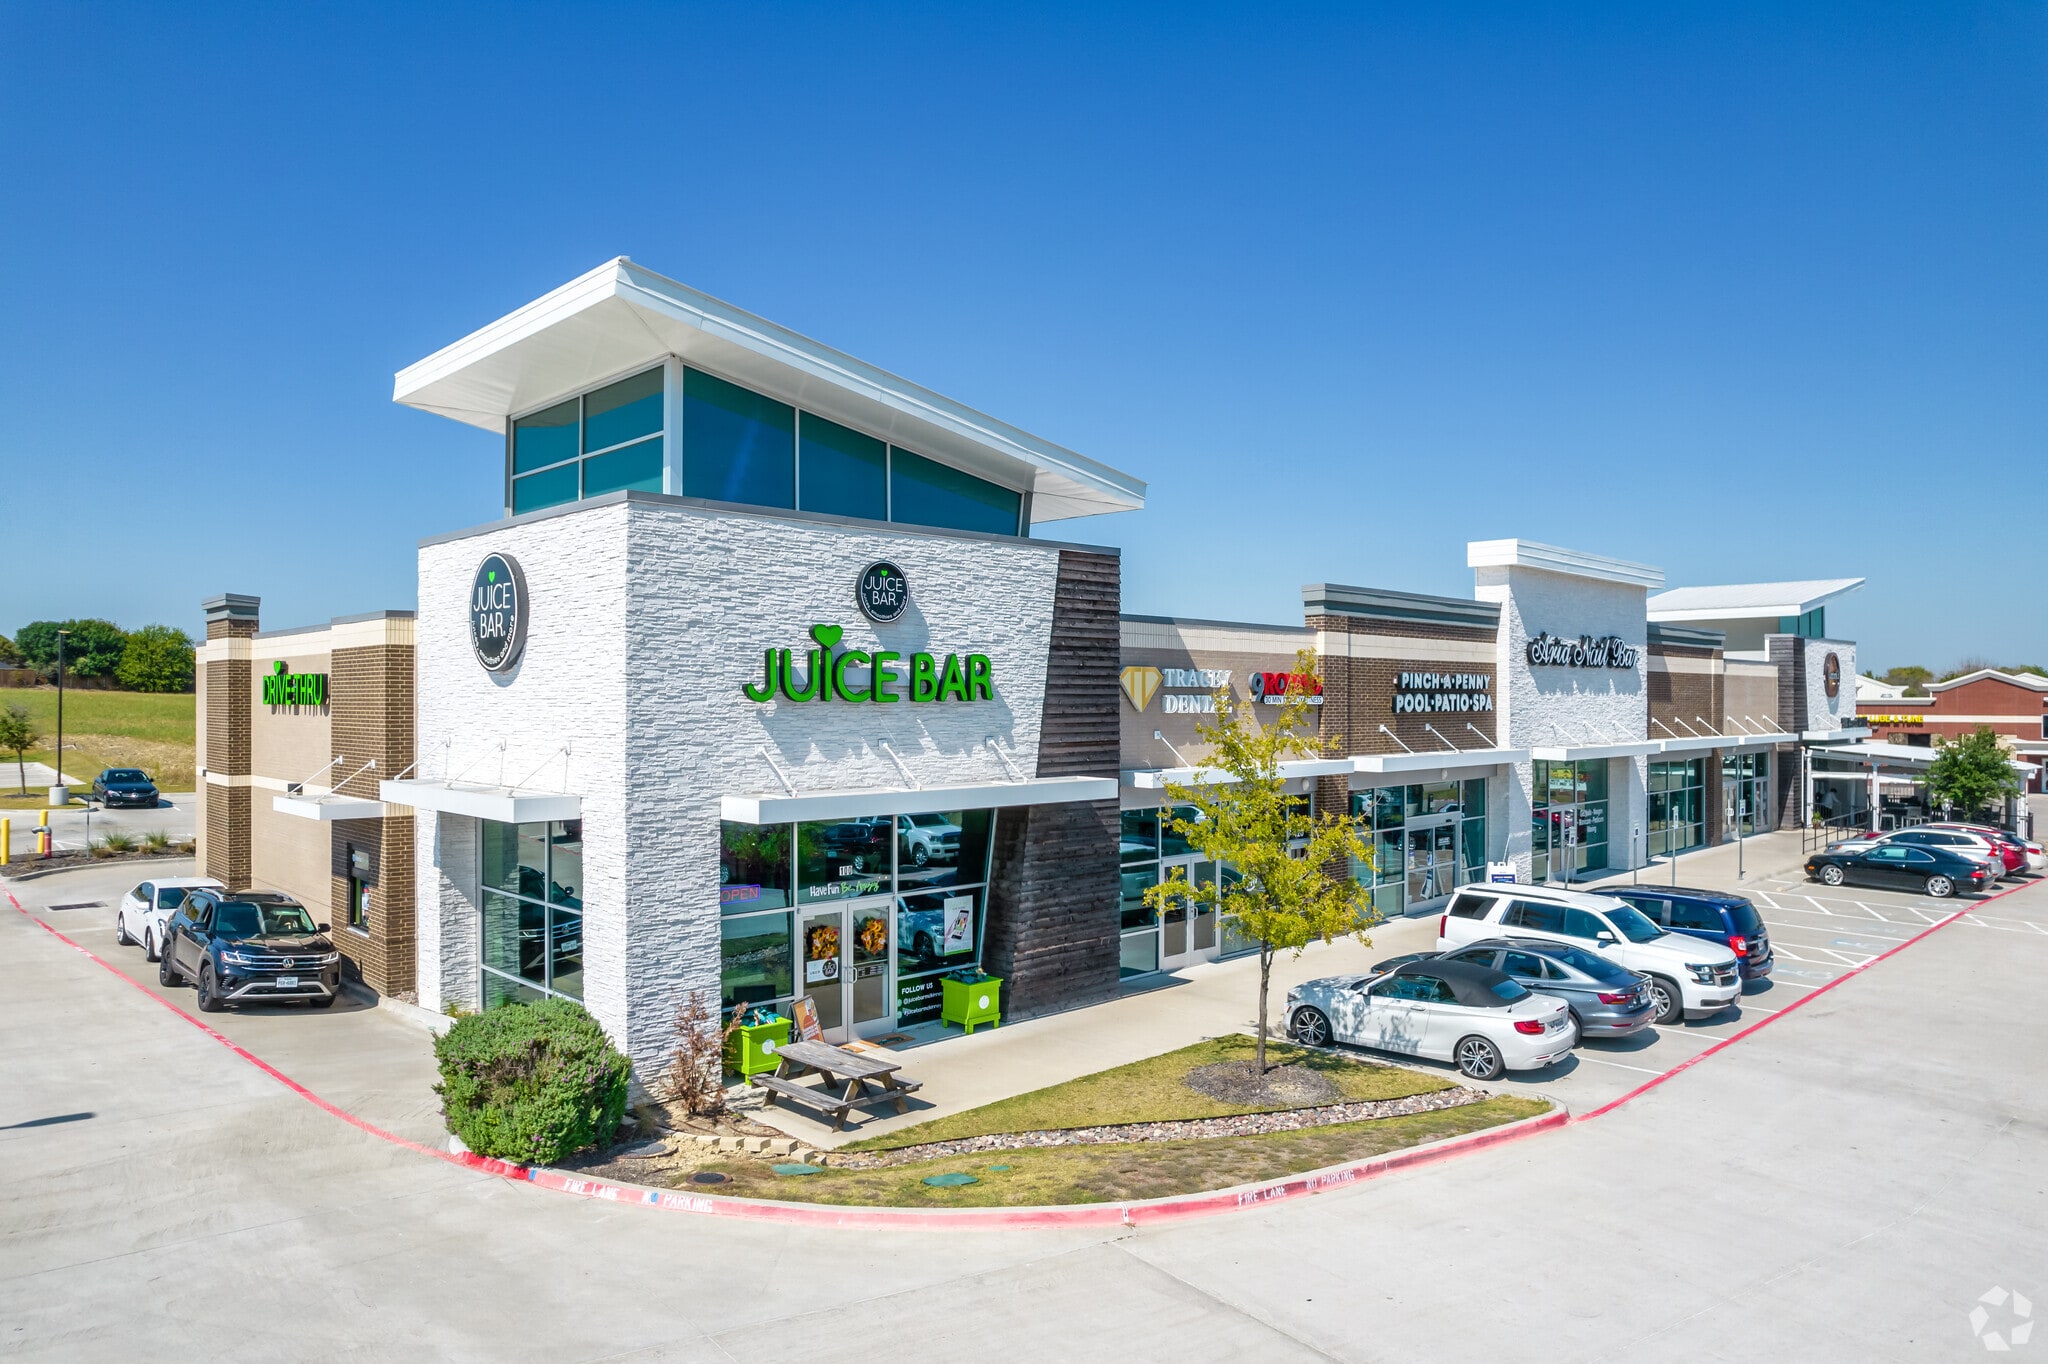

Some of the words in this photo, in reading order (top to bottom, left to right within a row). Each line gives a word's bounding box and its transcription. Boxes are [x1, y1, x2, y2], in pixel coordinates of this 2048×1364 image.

[865, 575, 904, 593] JUICE
[473, 582, 512, 612] JUICE
[872, 590, 897, 606] BAR
[480, 611, 504, 639] BAR
[500, 641, 509, 658] and
[506, 615, 515, 642] more
[1531, 634, 1572, 663] Aria
[1573, 637, 1609, 666] Nail
[1612, 638, 1639, 667] Bar
[742, 646, 900, 703] JUICE
[908, 651, 993, 703] BAR
[262, 672, 324, 706] DRIVE-THRU
[1893, 715, 1901, 724] &
[720, 886, 759, 901] OPEN
[810, 884, 828, 898] Have
[828, 882, 841, 895] Fun
[901, 983, 925, 996] FOLLOW
[926, 981, 934, 990] US
[1306, 1179, 1318, 1191] NO
[1321, 1168, 1355, 1185] PARKING
[563, 1178, 588, 1195] FIRE
[592, 1182, 620, 1201] LANE
[662, 1193, 713, 1213] PARKING
[1237, 1190, 1260, 1207] FIRE
[1263, 1185, 1288, 1200] LANE
